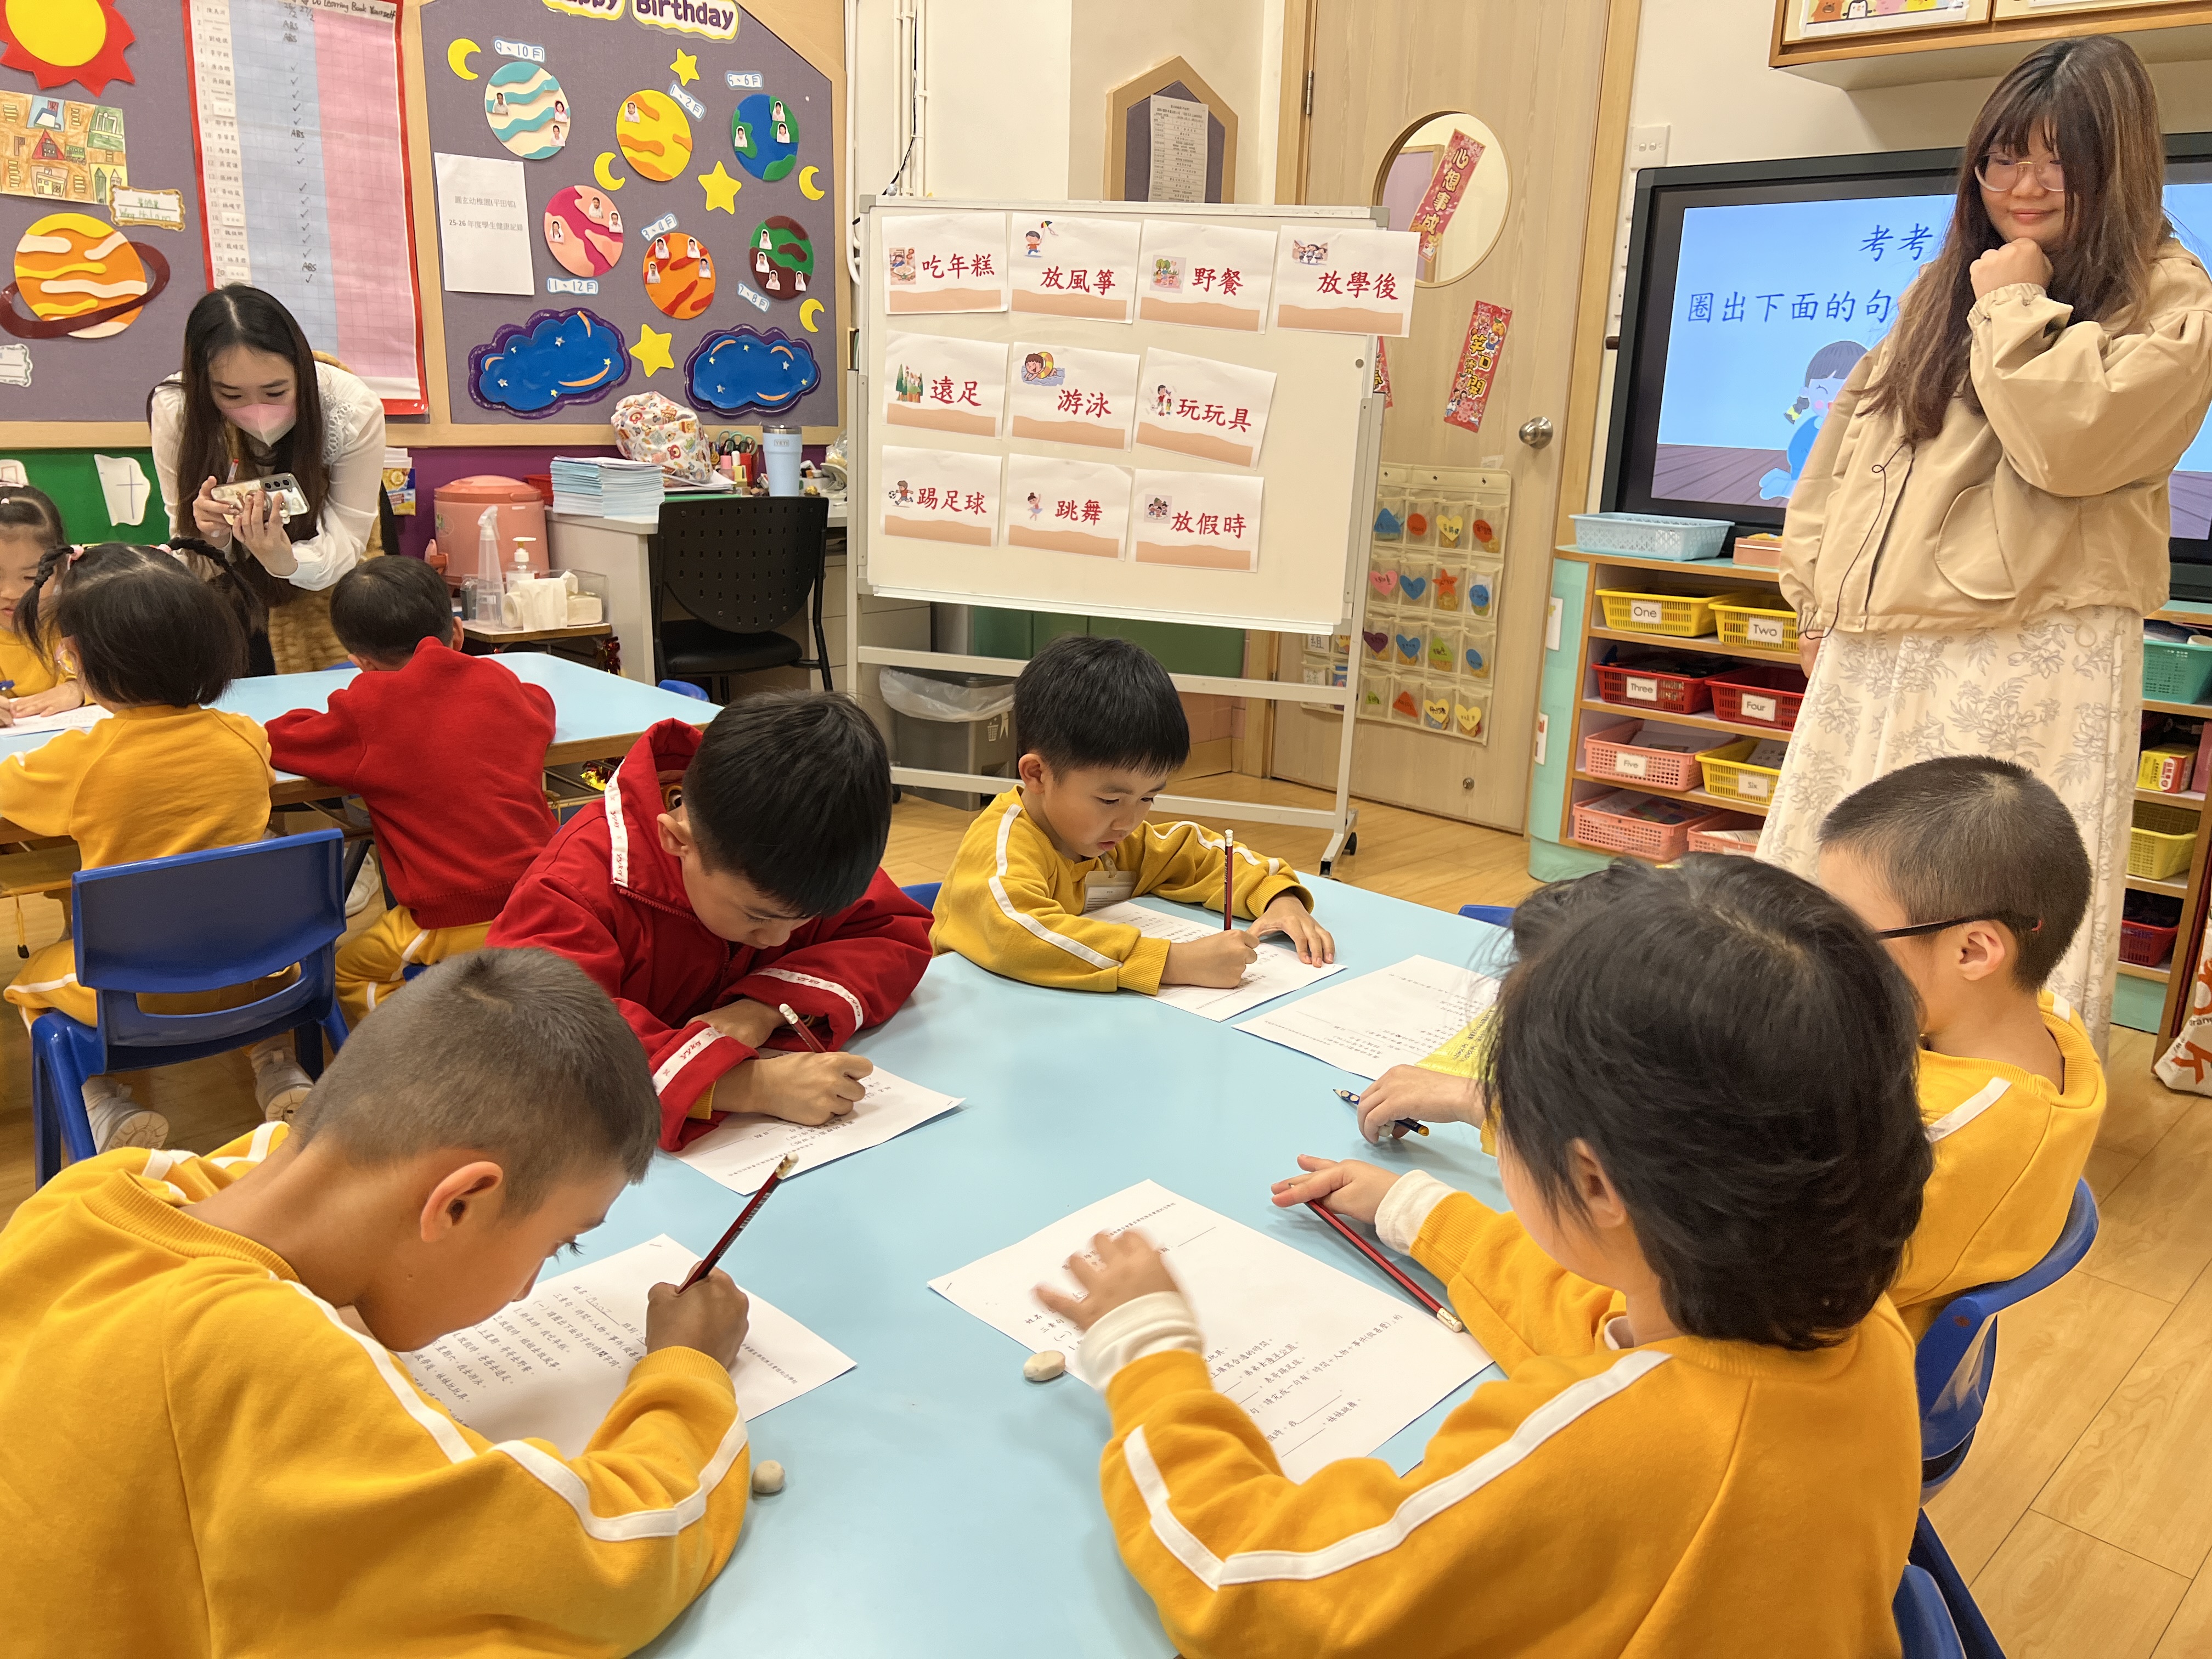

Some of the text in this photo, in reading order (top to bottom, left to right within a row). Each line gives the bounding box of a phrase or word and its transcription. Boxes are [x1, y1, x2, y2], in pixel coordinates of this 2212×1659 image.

[636, 0, 733, 30] Birthday
[1421, 147, 1469, 236] 心想事成
[1859, 223, 1933, 262] 考考
[922, 253, 996, 280] 吃年糕
[1040, 266, 1116, 296] 放風箏
[1191, 267, 1244, 296] 野餐
[1317, 270, 1398, 301] 放學後
[1688, 288, 1891, 324] 圈出下面的句
[929, 377, 981, 407] 遠足
[1057, 388, 1112, 418] 游泳
[1176, 398, 1252, 433] 玩玩具
[917, 487, 987, 515] 踢足球
[1055, 499, 1103, 526] 跳舞
[1171, 511, 1246, 539] 放假時
[1634, 607, 1657, 618] One
[1753, 624, 1778, 637] Two
[1630, 683, 1653, 693] Three
[1747, 701, 1766, 712] Four
[1623, 760, 1638, 768] Five
[1748, 781, 1757, 789] Six
